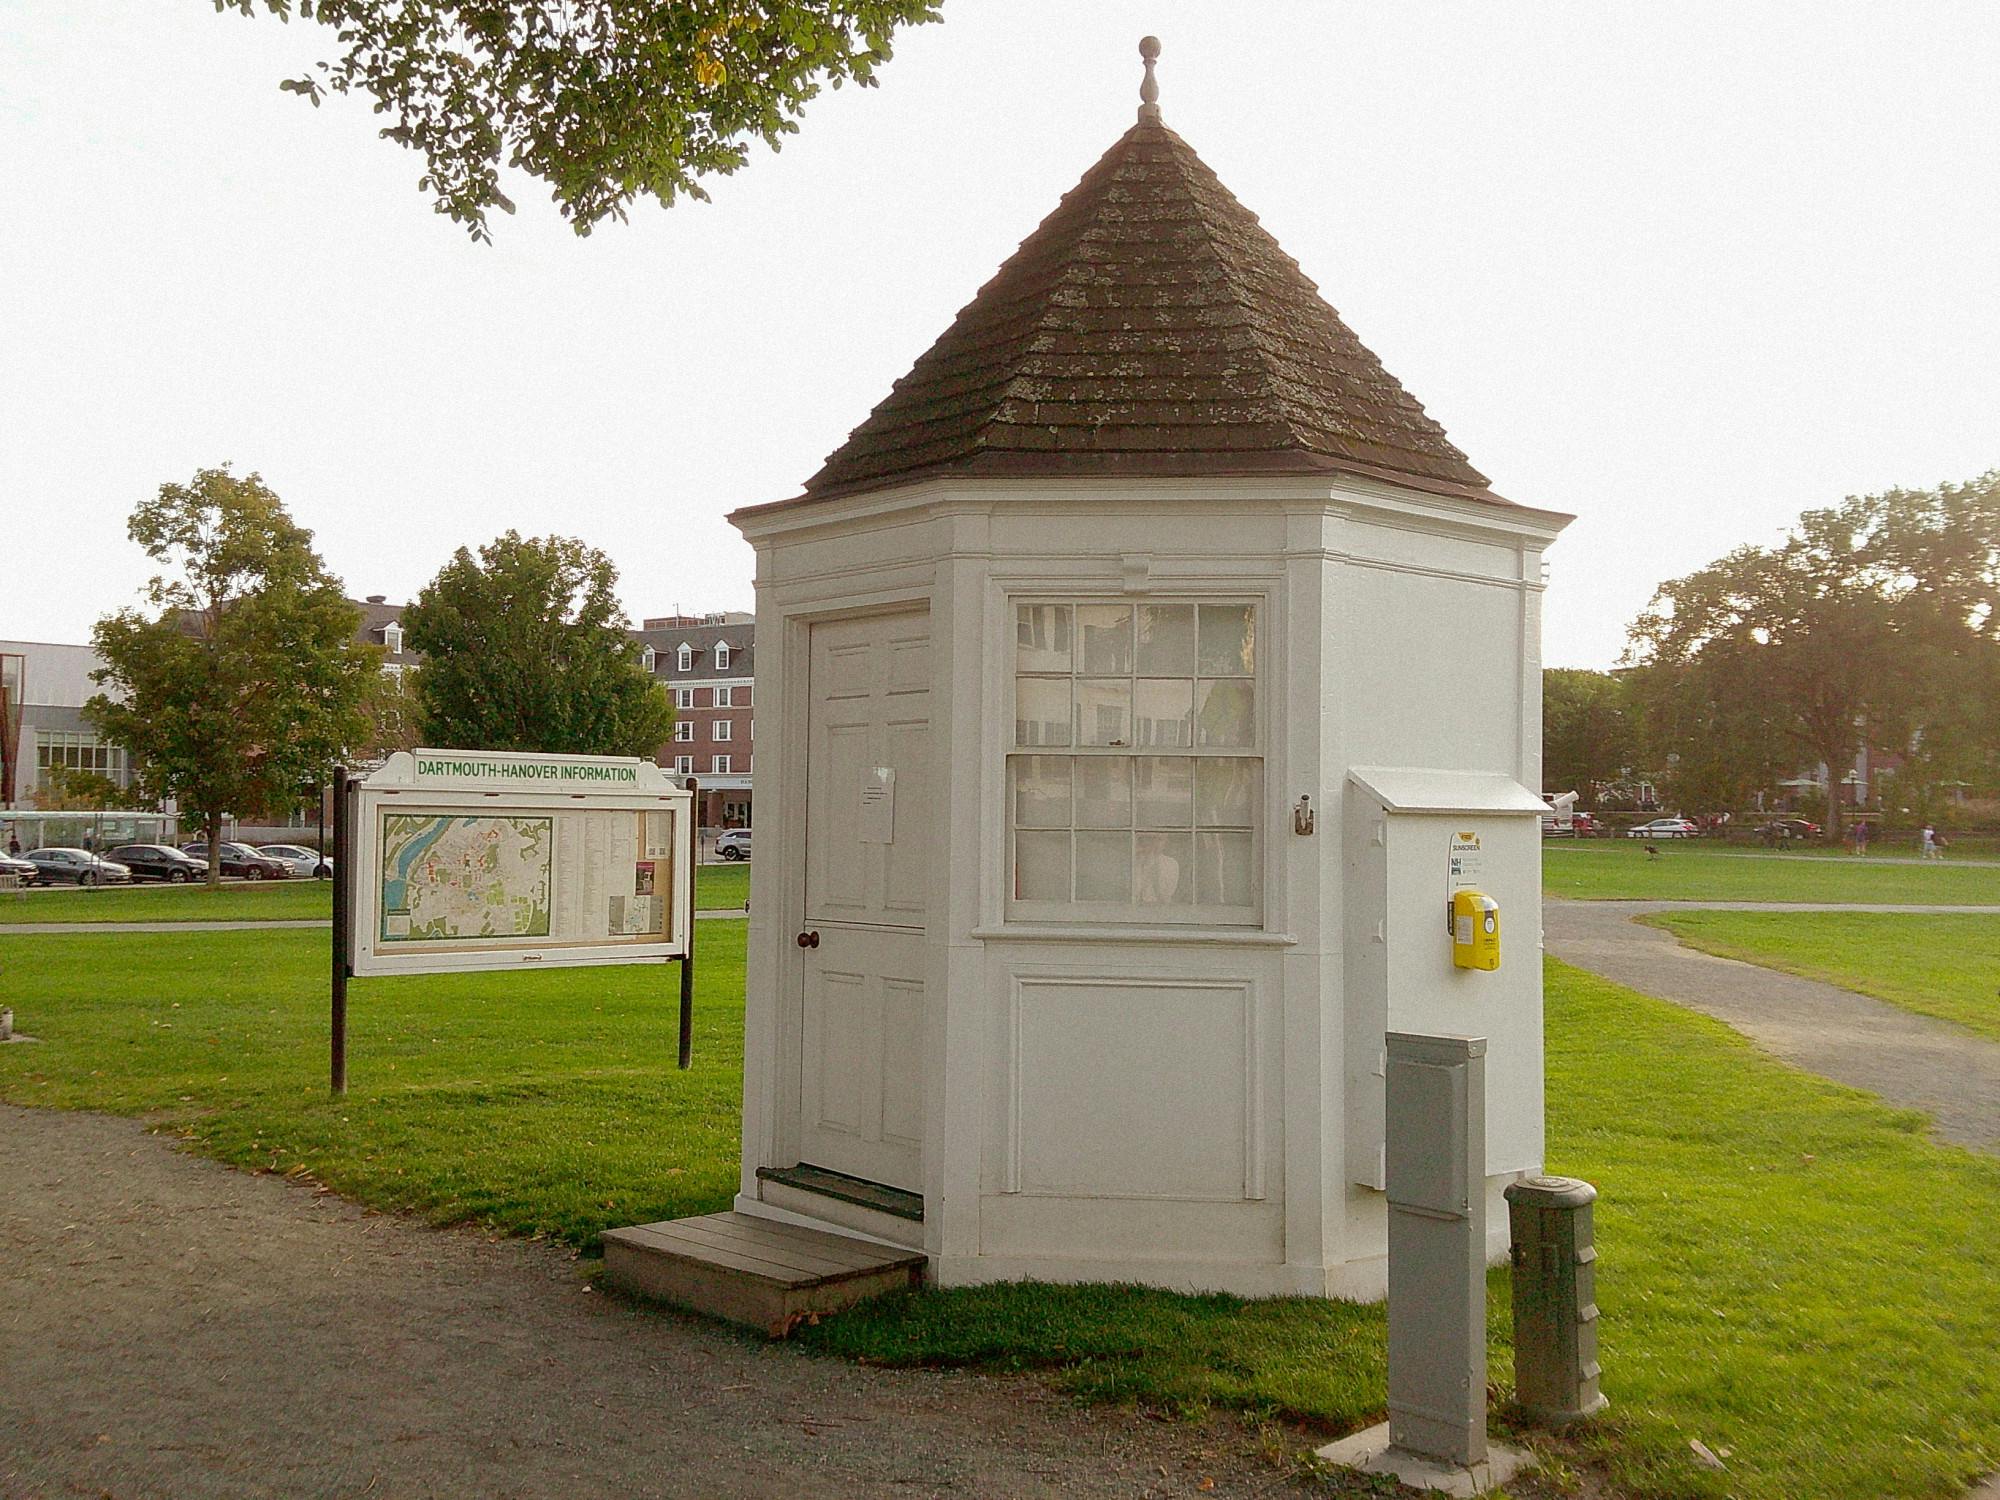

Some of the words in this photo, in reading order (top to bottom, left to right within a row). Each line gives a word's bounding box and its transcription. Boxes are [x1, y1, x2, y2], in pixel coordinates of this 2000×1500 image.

[418, 760, 558, 779] DARTMOUTH-HANOVER
[560, 765, 636, 782] INFORMATION
[1451, 858, 1461, 866] NH
